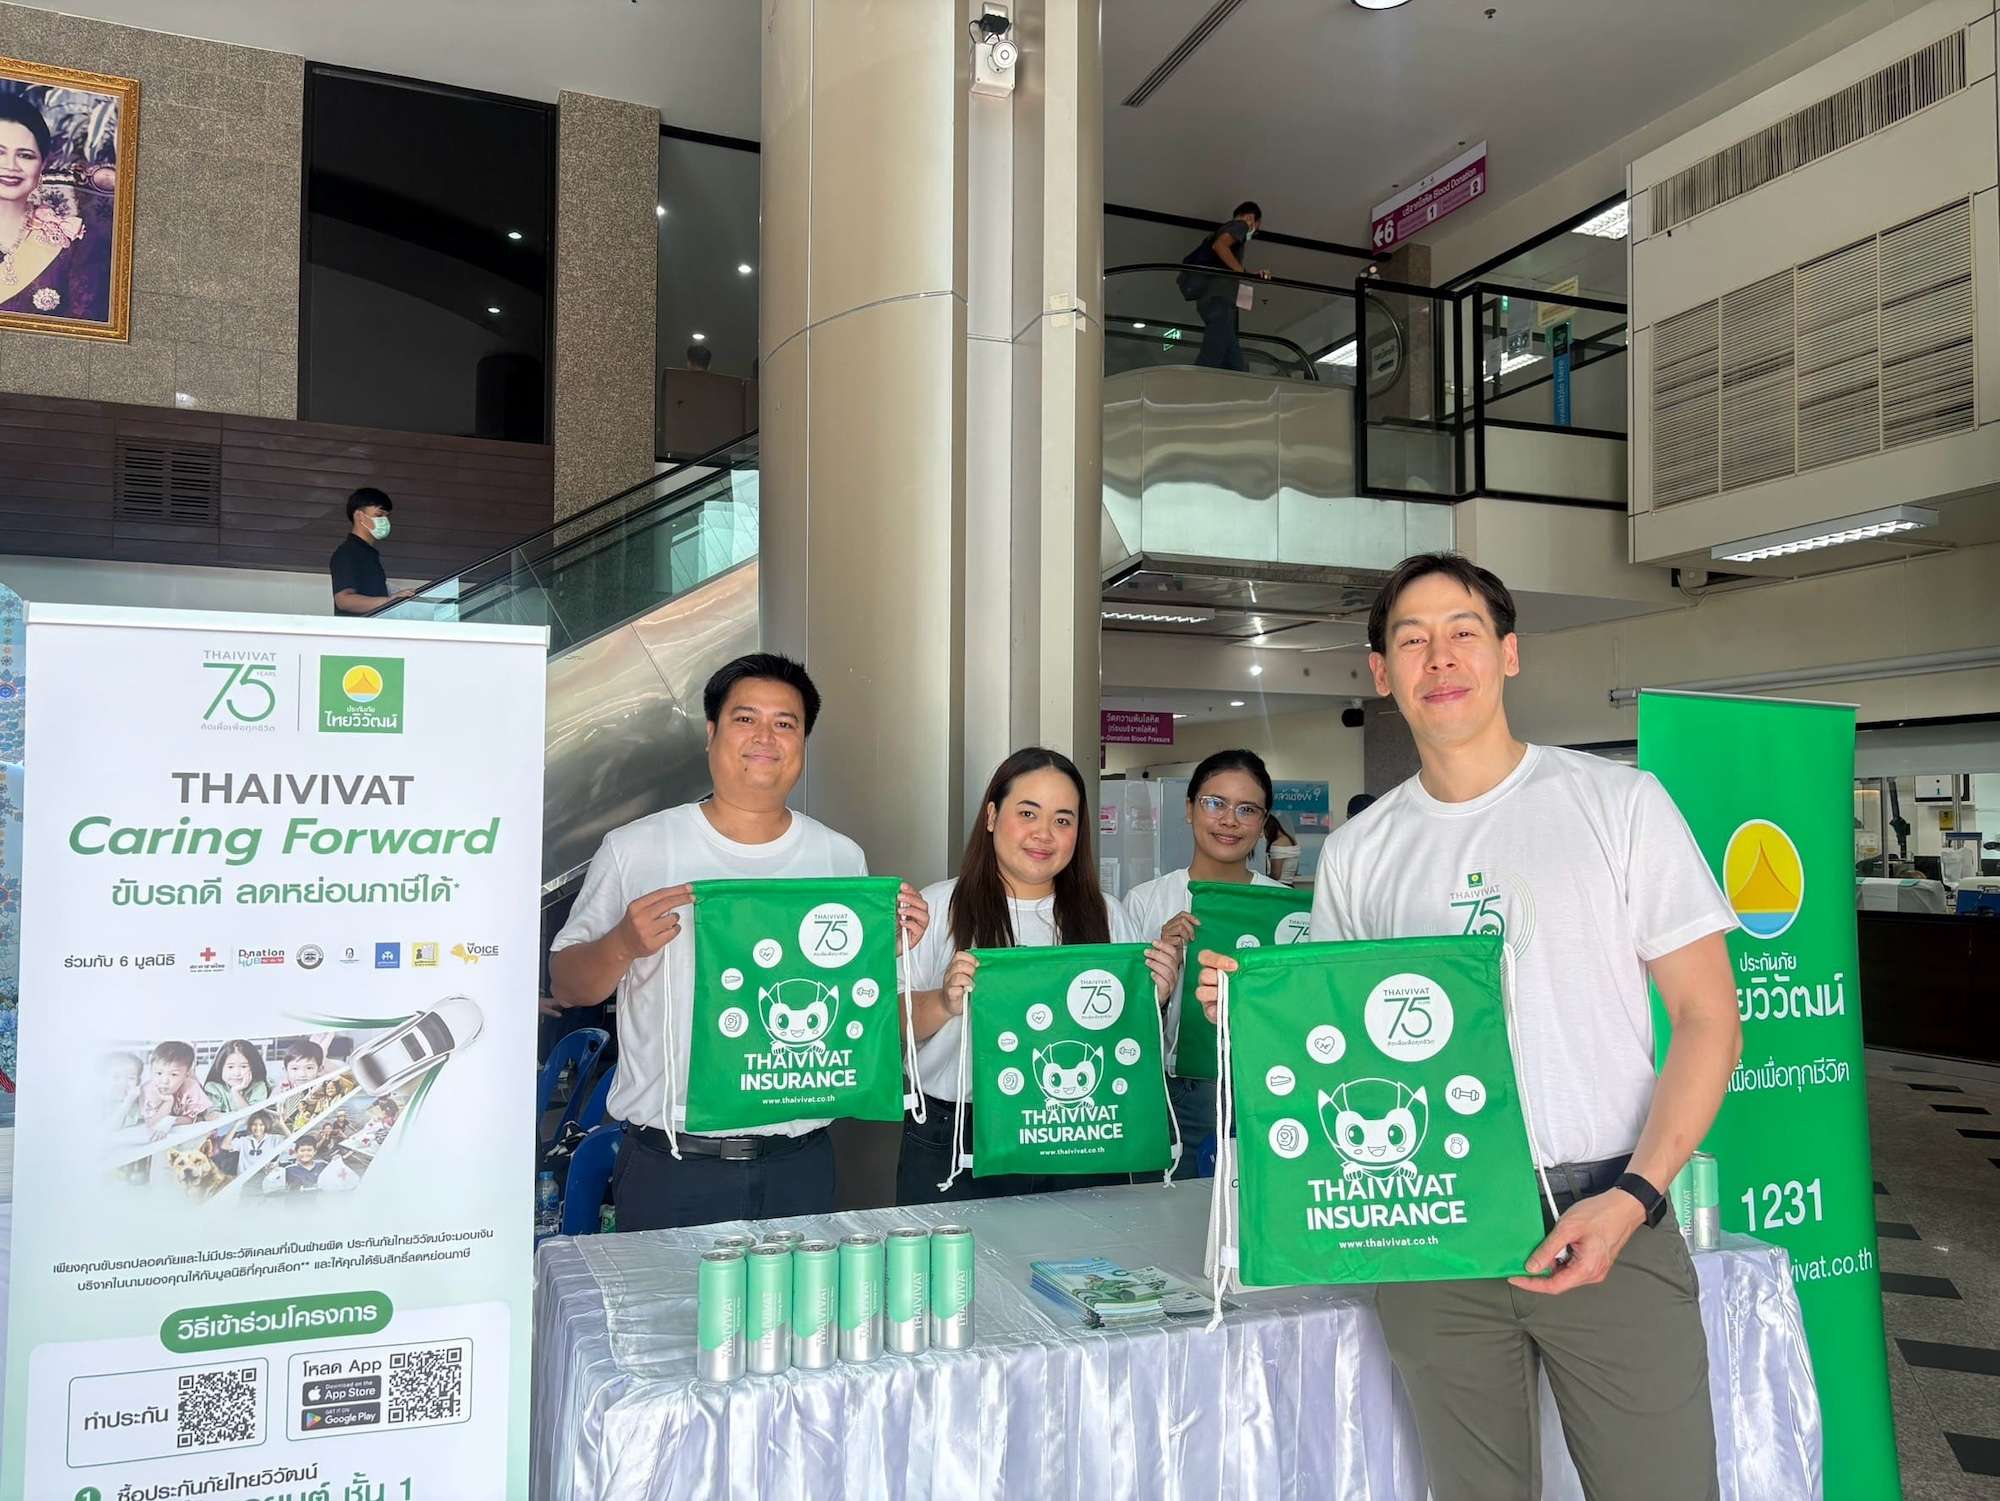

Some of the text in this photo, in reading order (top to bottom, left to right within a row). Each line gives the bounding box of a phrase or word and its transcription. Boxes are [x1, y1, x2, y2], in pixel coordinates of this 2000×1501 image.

[1384, 220, 1394, 244] 6
[203, 650, 277, 662] THAIVIVAT
[203, 662, 277, 722] 75
[324, 710, 399, 728] ไทยวิวัฒน์
[172, 771, 414, 805] THAIVIVAT
[68, 815, 501, 866] Caring Forward
[111, 877, 222, 906] ขับรถดี
[1449, 884, 1500, 900] THAIVIVAT
[1450, 894, 1505, 936] 75
[814, 920, 848, 951] 75
[64, 952, 176, 970] ร่วมกับ 6 มูลนิธิ
[467, 945, 499, 954] VOICE
[1739, 951, 1797, 973] ประกันภัย
[1080, 985, 1112, 1015] 75
[1383, 987, 1430, 996] THAIVIVAT
[1736, 972, 1845, 1022] ยวิวัฒน์
[1383, 996, 1432, 1039] 75
[743, 1049, 853, 1072] THAIVIVAT
[740, 1069, 857, 1091] INSURANCE
[1727, 1055, 1850, 1093] เผื่อเพื่อทุกชีวิต
[762, 1094, 836, 1106] www.thaivivat.co.th
[1021, 1104, 1119, 1126] THAIVIVAT
[1019, 1122, 1123, 1145] INSURANCE
[1039, 1146, 1105, 1156] www.thaivivat.co.th
[1307, 1172, 1458, 1203] THAIVIVAT
[1306, 1200, 1468, 1230] INSURANCE
[1741, 1178, 1824, 1233] 1231
[1338, 1234, 1440, 1250] www.thaivivat.co.th
[1791, 1246, 1873, 1283] ivat.co.th
[912, 1272, 922, 1329] THAIVIVAT
[177, 1302, 378, 1341] วิธีเข้าร่วมโครงการ
[303, 1359, 382, 1378] โหลด App
[325, 1387, 376, 1400] App Store
[84, 1405, 169, 1431] ทำประกัน
[324, 1411, 376, 1424] Google Play
[117, 1462, 318, 1501] ซื้อประกันภัยไทยวิวัฒน์
